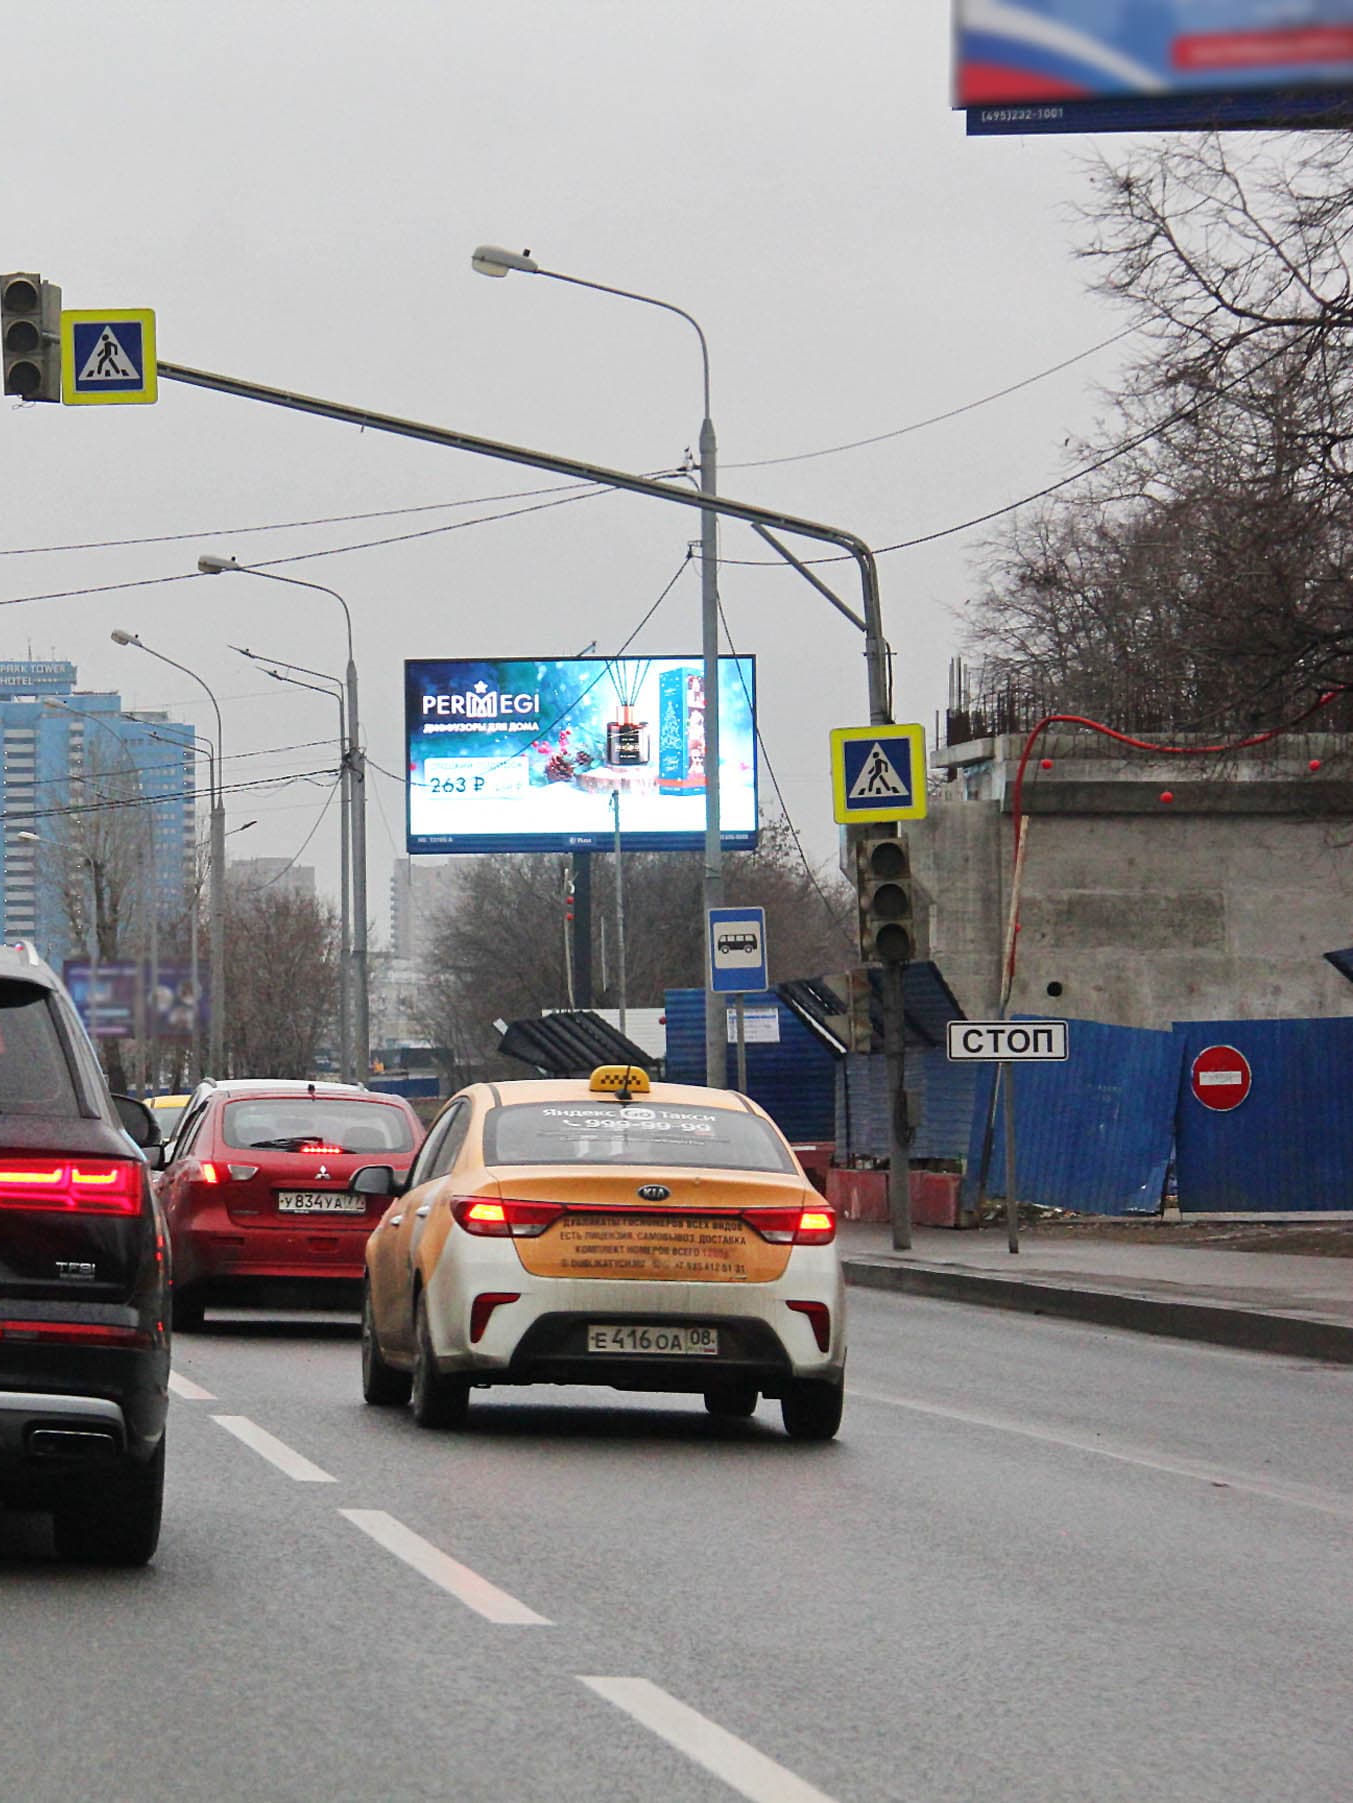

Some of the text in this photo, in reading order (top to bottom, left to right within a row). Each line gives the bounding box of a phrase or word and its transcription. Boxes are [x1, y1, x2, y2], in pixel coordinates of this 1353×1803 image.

[31, 664, 65, 673] TOWER
[0, 676, 33, 685] HOTEL
[508, 722, 540, 733] ДОМА
[430, 776, 466, 793] 263
[962, 1029, 1054, 1054] СТОП
[543, 1108, 617, 1118] Яндекс
[659, 1110, 716, 1122] Такси
[642, 1188, 665, 1199] KIA
[284, 1194, 343, 1209] У834УА
[55, 1261, 96, 1273] TFSI
[594, 1328, 711, 1351] Е416ОА 08
